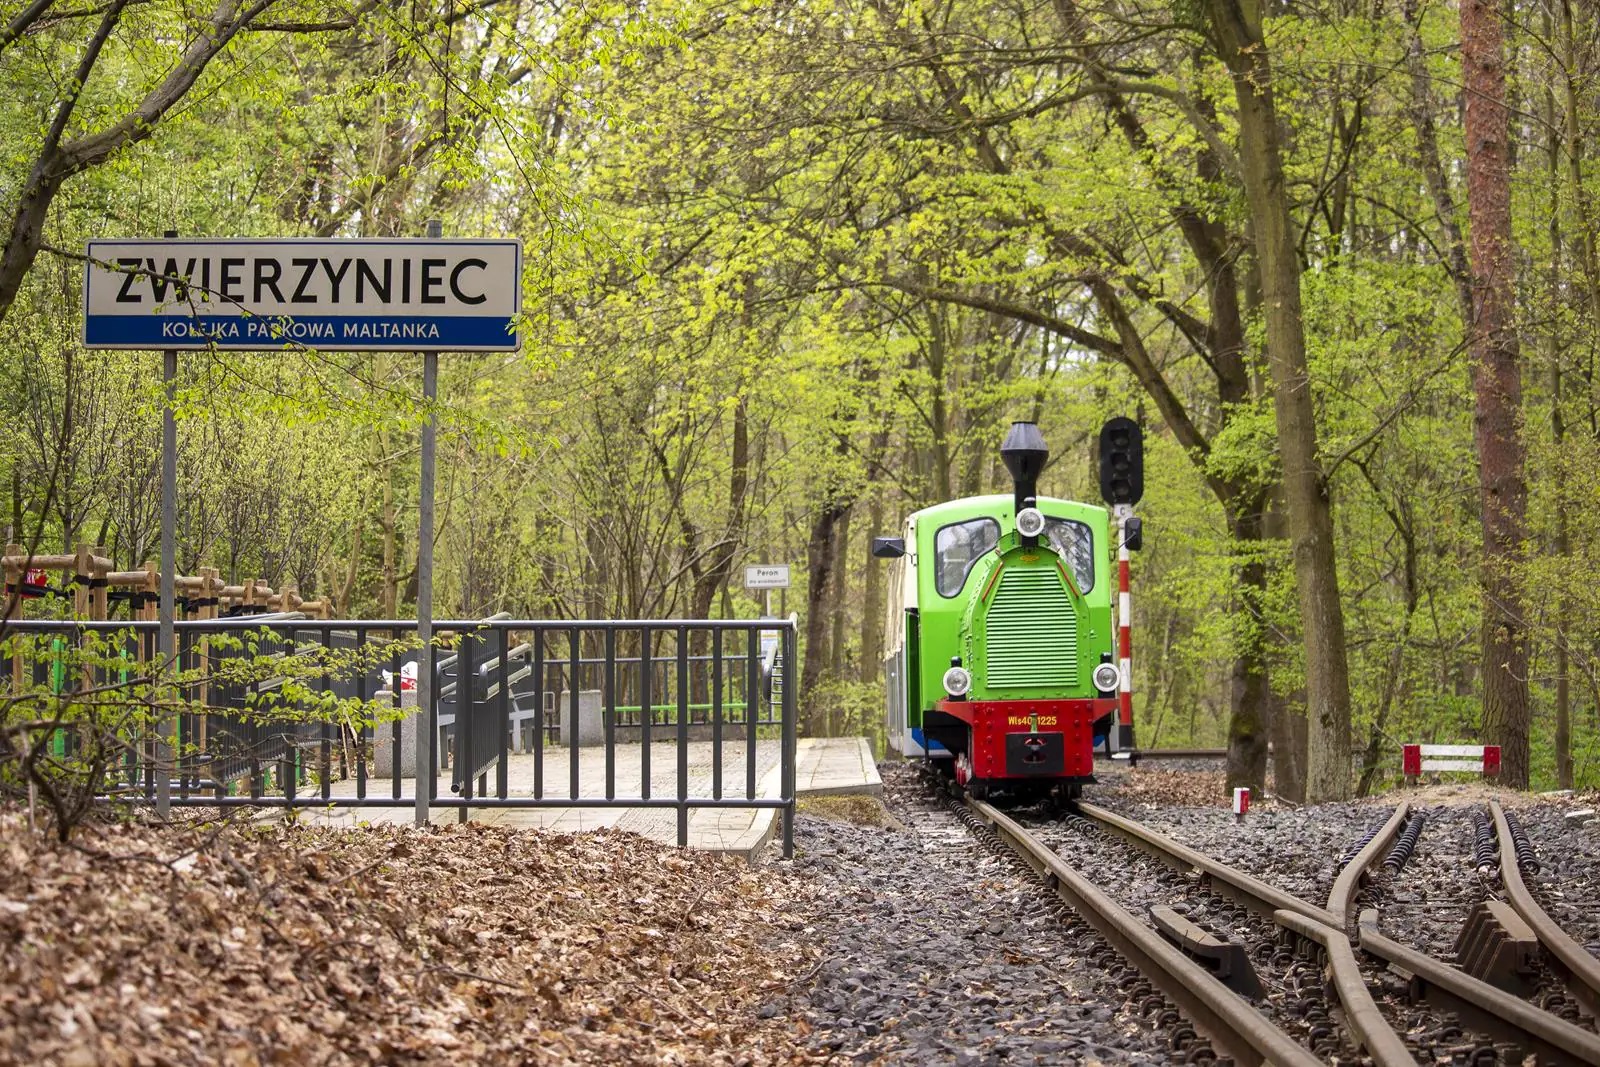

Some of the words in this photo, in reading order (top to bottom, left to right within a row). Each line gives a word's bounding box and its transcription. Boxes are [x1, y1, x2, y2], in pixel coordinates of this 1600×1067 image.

[116, 257, 488, 305] ZWIERZYNIEC
[343, 323, 440, 338] MALTANKA
[757, 569, 779, 577] Peron
[1037, 716, 1057, 726] 1225
